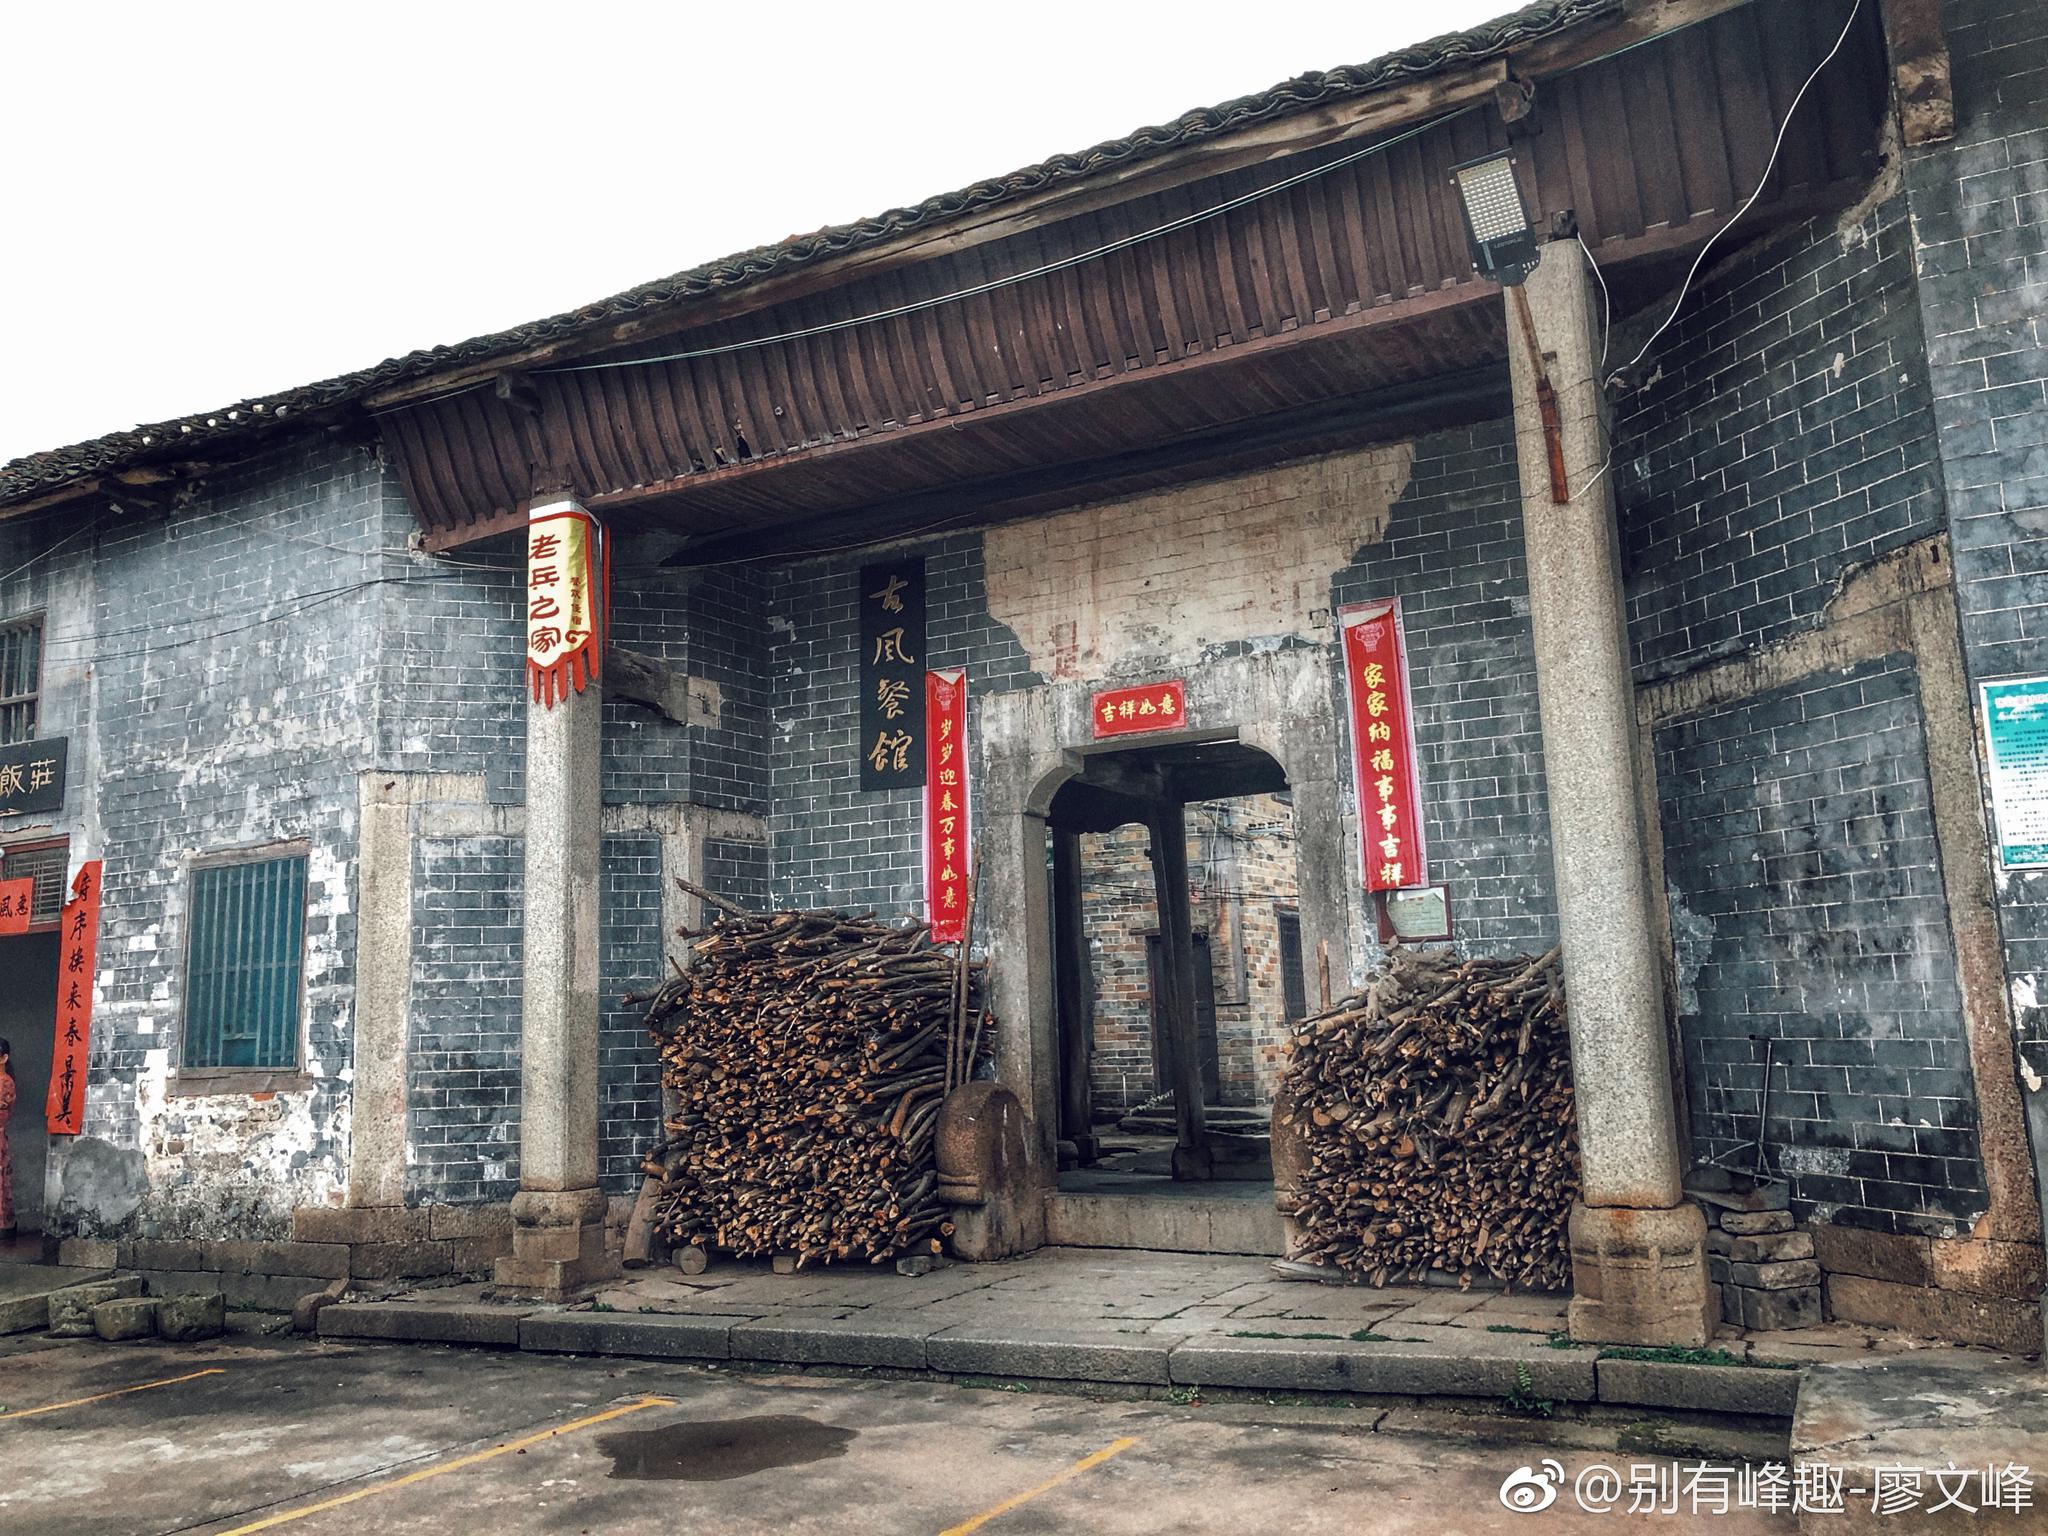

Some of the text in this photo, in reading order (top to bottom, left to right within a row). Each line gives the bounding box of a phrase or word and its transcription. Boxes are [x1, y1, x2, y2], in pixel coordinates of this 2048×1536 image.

[529, 533, 562, 653] 老兵之家
[1100, 693, 1176, 723] 吉祥如意
[937, 718, 959, 909] 岁岁迎春万事如意
